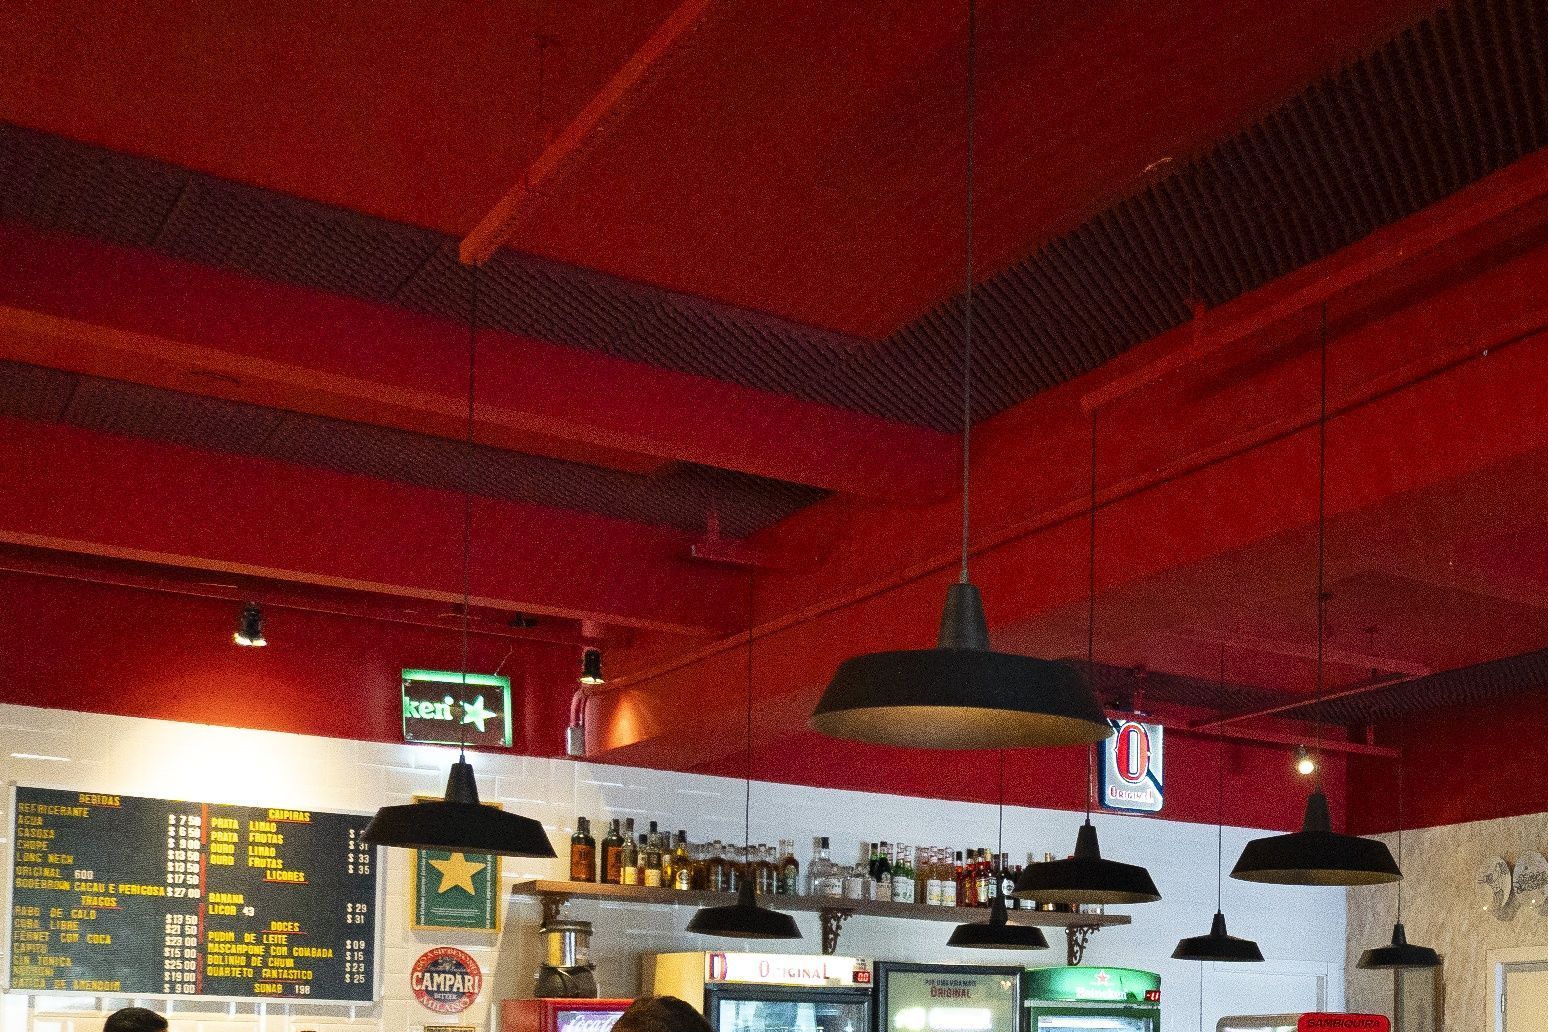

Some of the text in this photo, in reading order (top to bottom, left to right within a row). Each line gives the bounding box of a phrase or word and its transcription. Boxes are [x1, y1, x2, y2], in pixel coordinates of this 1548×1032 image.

[79, 794, 121, 806] BEBIDAS
[18, 803, 89, 818] REFRIGERANTE
[268, 808, 311, 821] CAIPIRAS
[211, 817, 239, 829] PRATA
[210, 831, 239, 843] PRATA
[249, 833, 284, 844] FRUTAS
[210, 843, 235, 854] OURO
[210, 854, 235, 866] OURO
[249, 857, 283, 869] FRUTAS
[16, 866, 61, 877] ORIGINAL
[74, 870, 94, 880] 600
[266, 870, 305, 882] LICORES
[109, 884, 116, 894] E
[209, 892, 244, 904] BANANA
[208, 904, 237, 916] LICOR
[242, 906, 255, 917] 43
[271, 921, 300, 932] DOCES
[208, 931, 235, 942] PUDIM
[244, 933, 256, 943] DE
[263, 934, 288, 945] LEITE
[207, 943, 265, 955] MASCARPONE
[270, 946, 288, 956] COM
[293, 947, 333, 958] GOIABADA
[207, 954, 246, 966] BOLINHO
[252, 956, 263, 967] DE
[207, 967, 253, 978] QUARTETO
[262, 968, 313, 980] FANTASTICO
[254, 983, 311, 994] SUNAB 198
[412, 971, 480, 995] CAMPARI
[930, 986, 971, 998] ORIGINAL
[1307, 1018, 1381, 1028] SAMBIQUIRA
